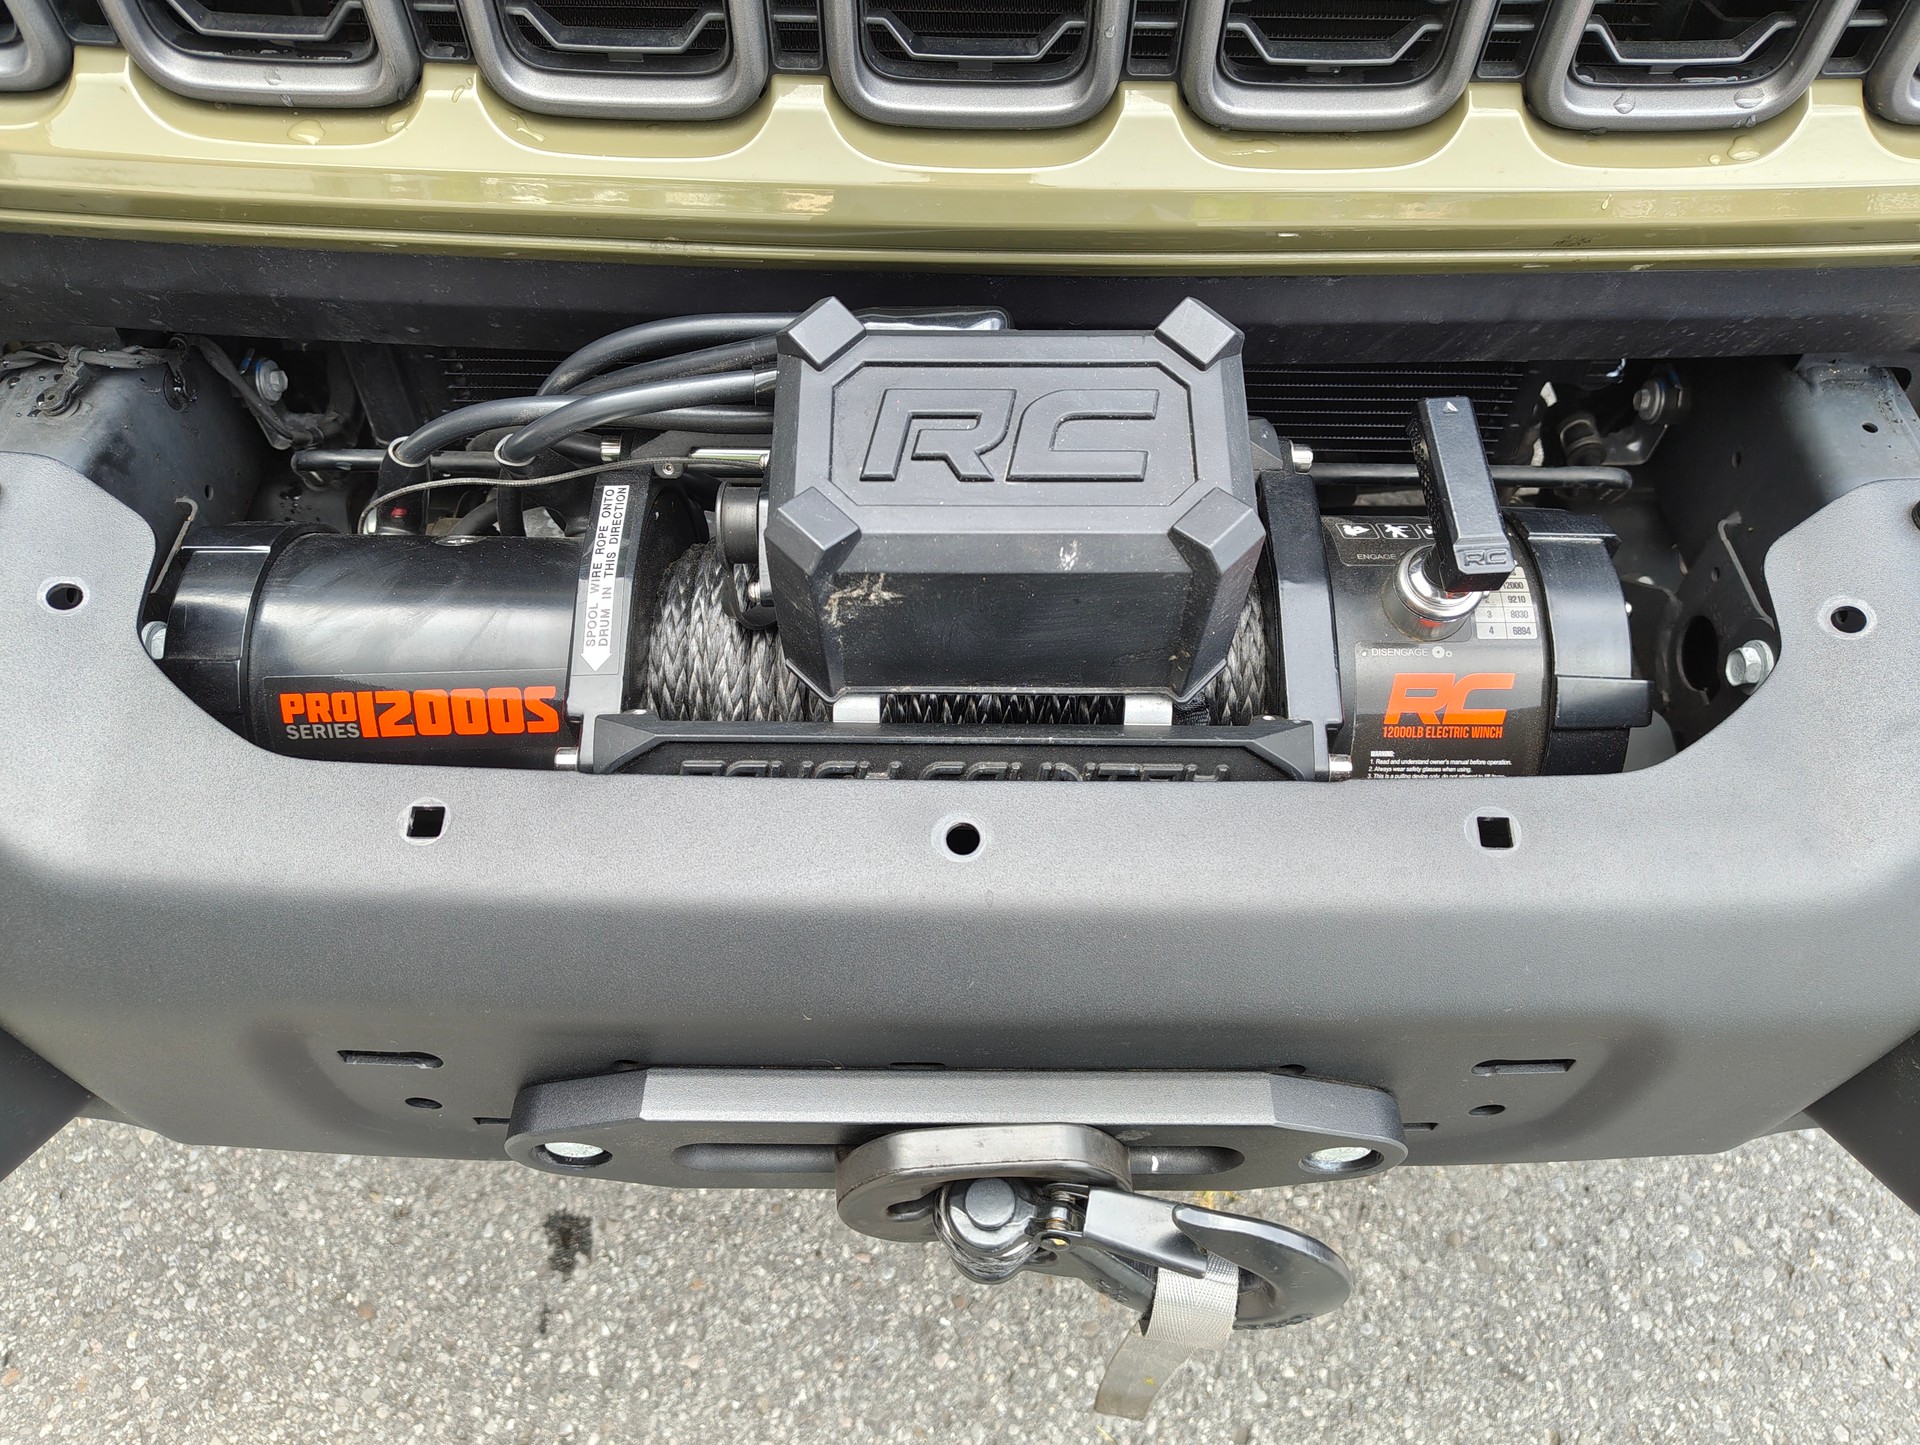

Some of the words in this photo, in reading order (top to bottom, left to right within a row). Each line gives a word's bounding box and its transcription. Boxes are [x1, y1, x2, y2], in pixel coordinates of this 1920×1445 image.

[859, 388, 1160, 482] RC
[601, 489, 615, 518] ONTO
[609, 487, 627, 545] DIRECTION
[595, 525, 609, 555] ROPE
[604, 552, 617, 578] THIS
[1464, 549, 1507, 567] RC
[590, 562, 603, 594] WIRE
[602, 586, 612, 600] IN
[1507, 595, 1526, 603] 9210
[586, 602, 599, 647] SPOOL
[599, 608, 610, 647] DRUM
[1487, 610, 1492, 618] 3
[1510, 610, 1528, 618] 8030
[1488, 626, 1494, 634] 4
[1512, 627, 1531, 635] 6894
[1371, 648, 1429, 656] DISENGAGE
[280, 692, 357, 724] PRO
[356, 686, 560, 738] 12000S
[1383, 672, 1515, 725] RC
[286, 723, 360, 740] SERIES
[1383, 726, 1423, 738] 12000LB
[1425, 726, 1469, 738] ELECTRIC
[1471, 726, 1503, 738] WINCH
